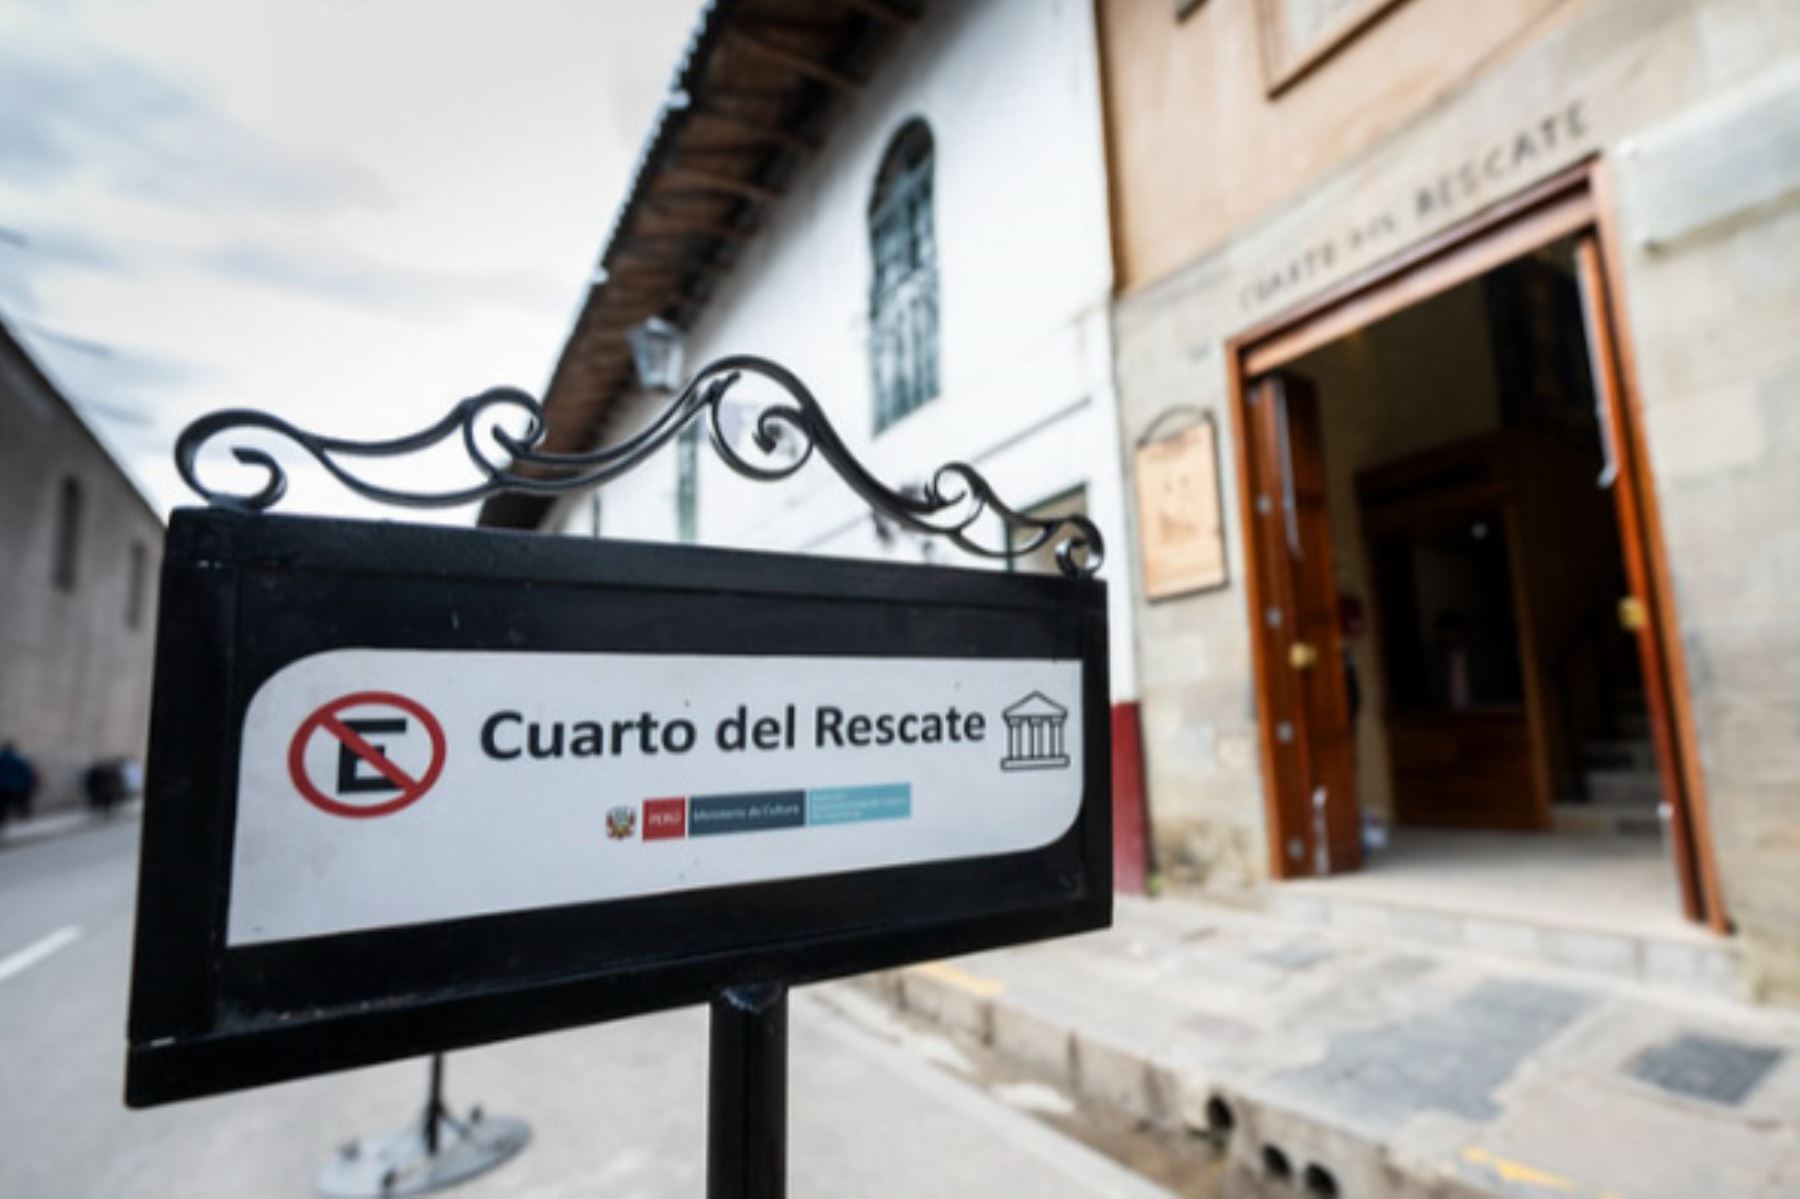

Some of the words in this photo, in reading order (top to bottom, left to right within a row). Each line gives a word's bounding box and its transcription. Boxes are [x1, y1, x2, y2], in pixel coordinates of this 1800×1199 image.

[1414, 101, 1587, 218] RESCATE
[336, 717, 408, 796] E
[479, 709, 697, 761] Cuarto
[715, 704, 796, 751] del
[814, 705, 987, 748] Rescate
